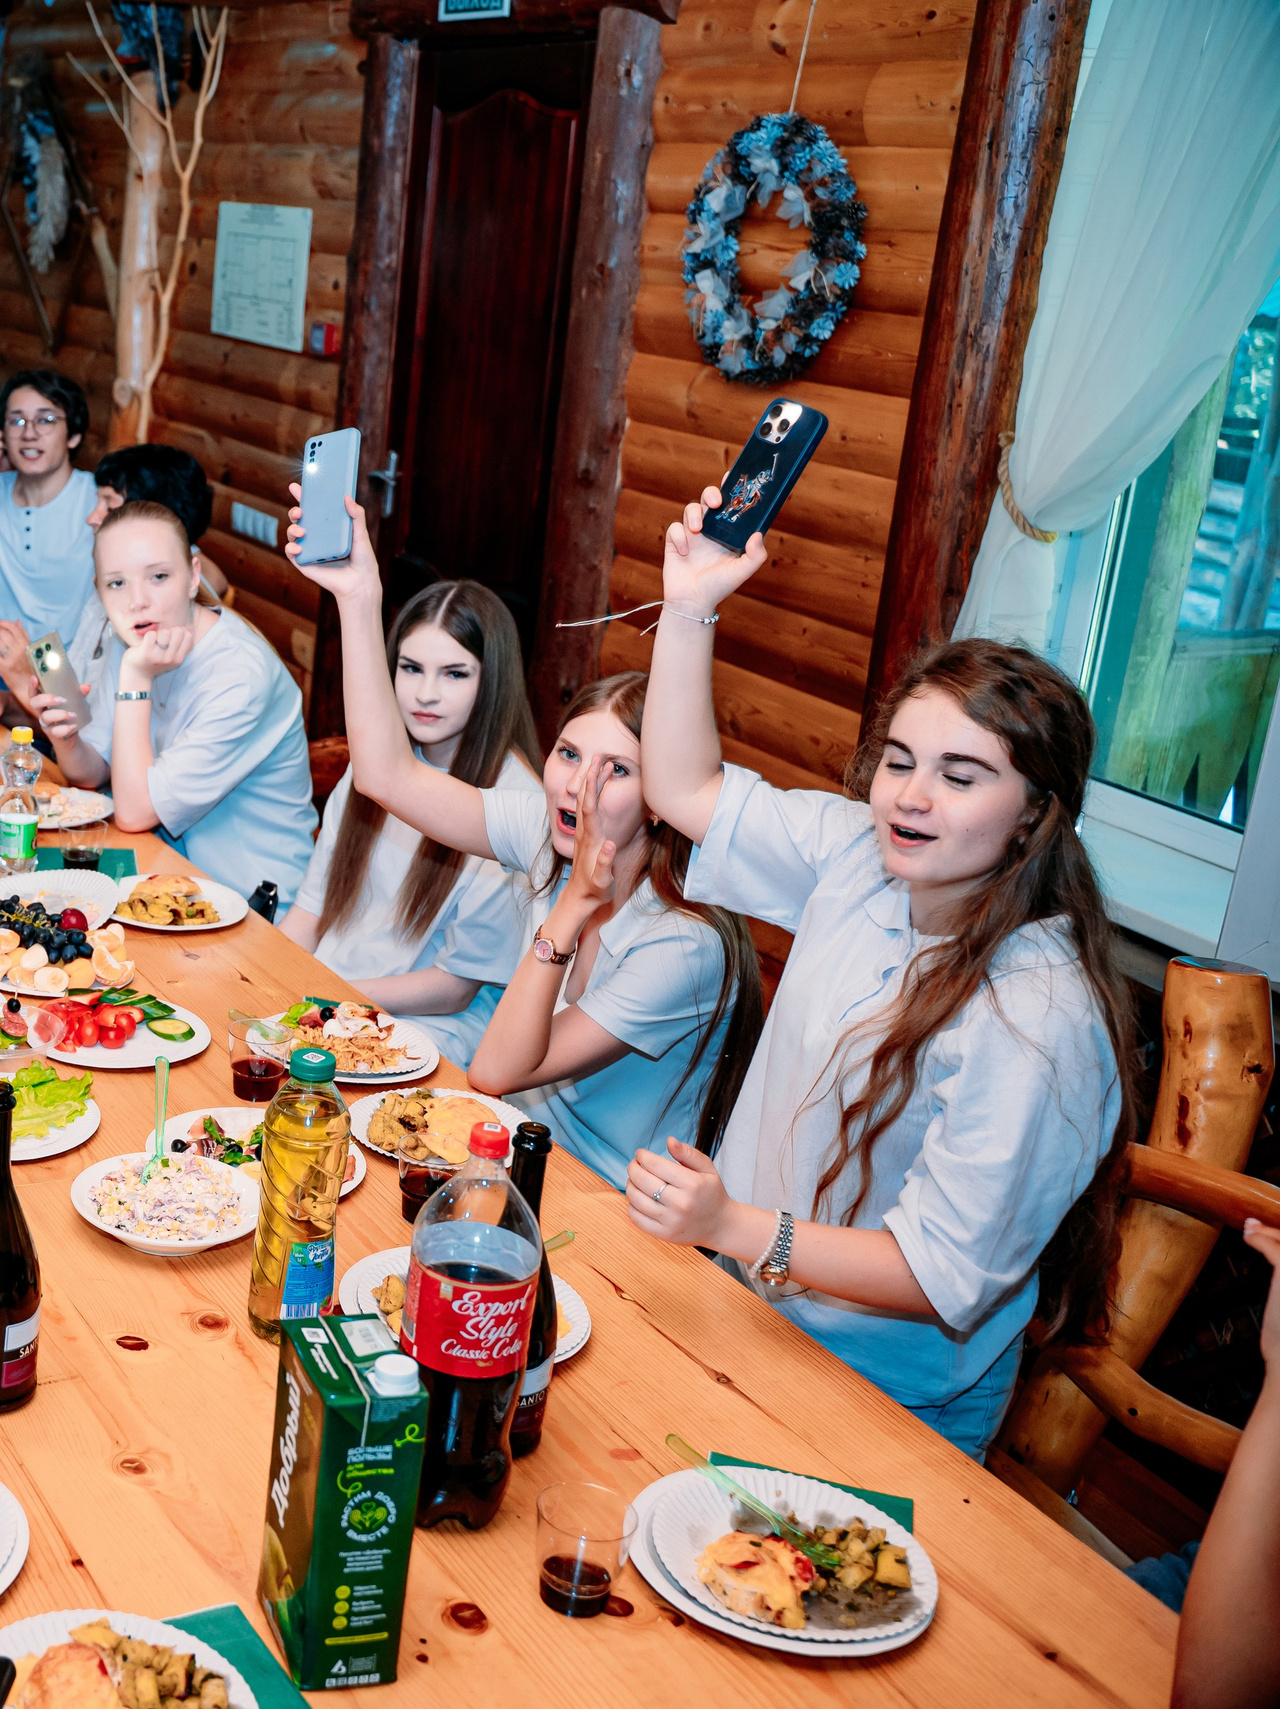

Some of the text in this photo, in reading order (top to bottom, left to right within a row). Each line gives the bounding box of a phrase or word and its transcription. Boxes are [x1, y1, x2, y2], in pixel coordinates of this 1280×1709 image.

[452, 1284, 532, 1329] Export
[460, 1316, 518, 1348] Style
[441, 1338, 522, 1360] Classic Cola
[271, 1371, 301, 1529] Добрый
[374, 1491, 397, 1524] ДОБРО
